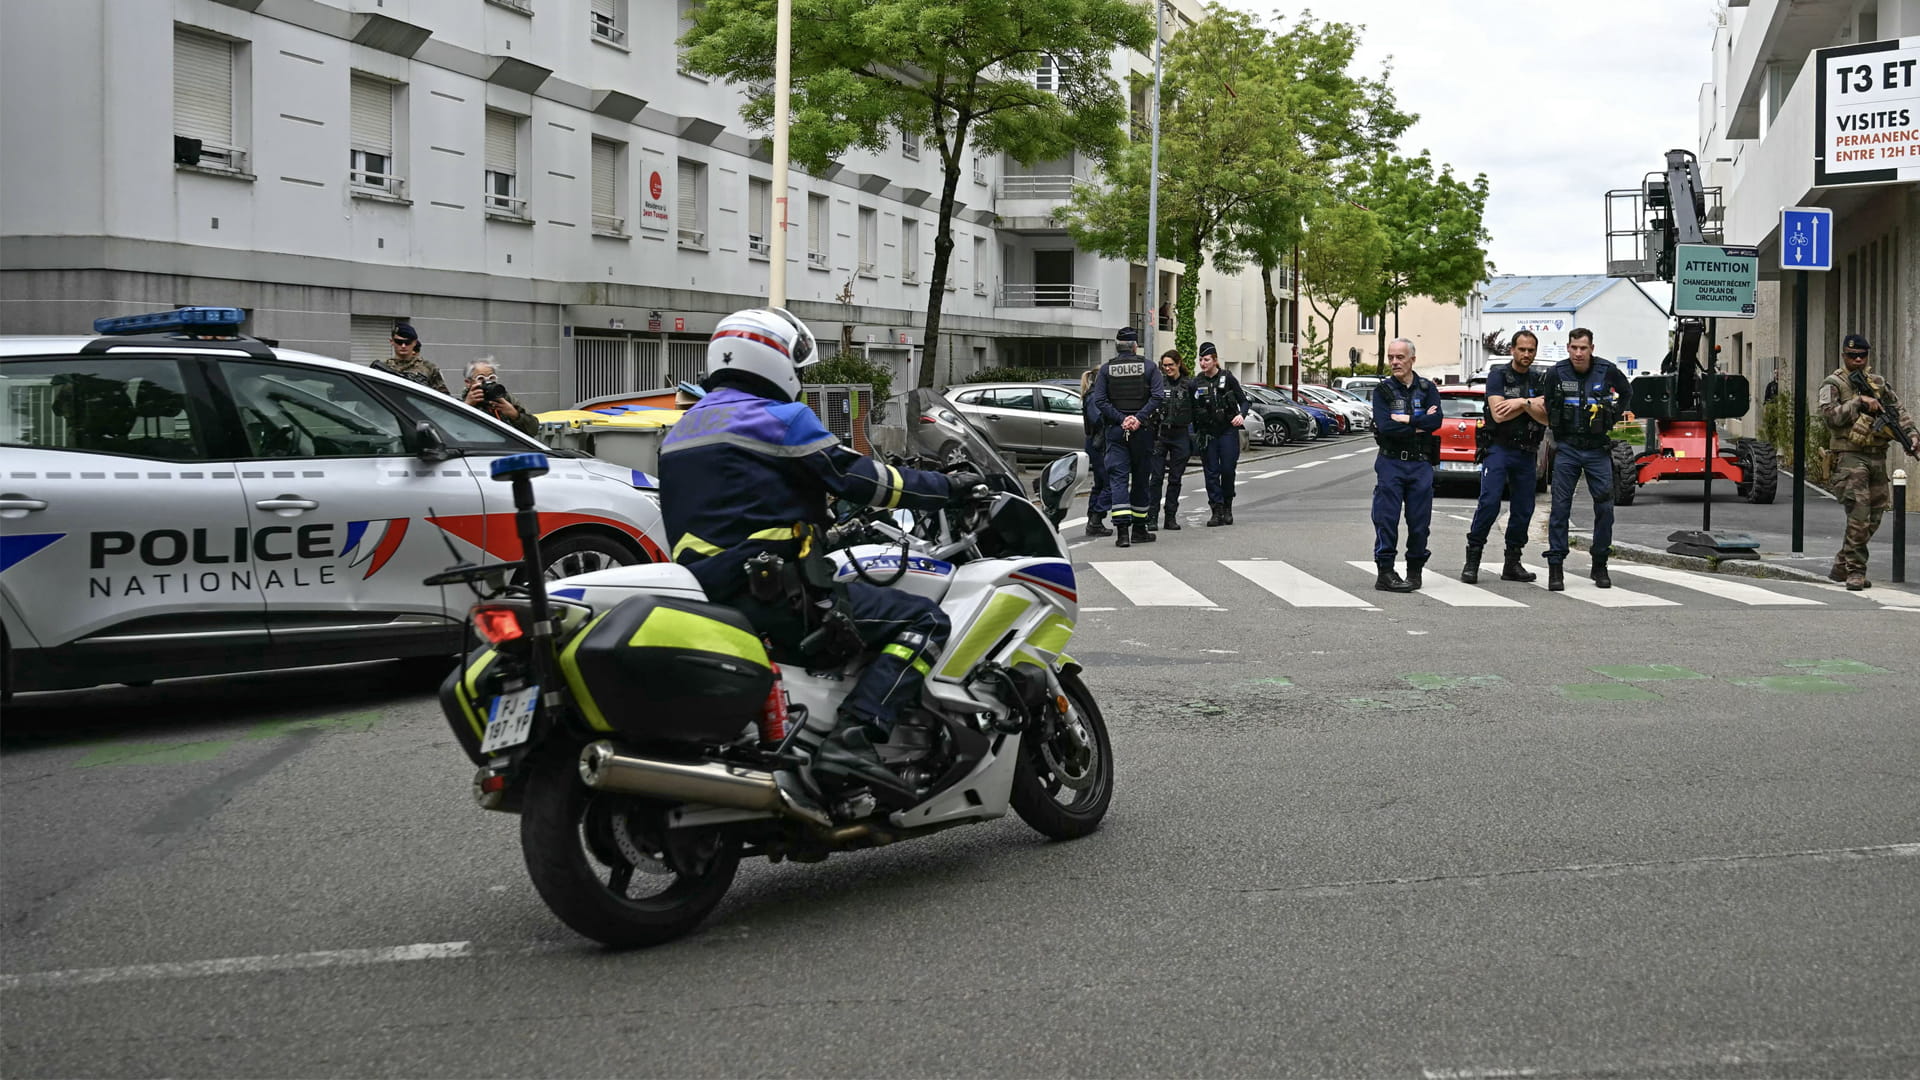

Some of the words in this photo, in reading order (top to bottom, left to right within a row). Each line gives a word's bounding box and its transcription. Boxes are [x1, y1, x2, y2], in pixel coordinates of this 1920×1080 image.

[1836, 64, 1873, 94] T3
[1882, 59, 1918, 90] ET
[1836, 109, 1911, 132] VISITES
[1836, 129, 1920, 147] PERMANENC
[1836, 148, 1875, 163] ENTRE
[1881, 146, 1905, 158] 12H
[1685, 261, 1749, 273] ATTENTION
[1682, 279, 1726, 287] CHANGEMENT
[1696, 294, 1737, 302] CIRCULATION
[1111, 364, 1143, 375] POLICE
[90, 524, 334, 569] POLICE
[90, 565, 335, 598] NATIONALE
